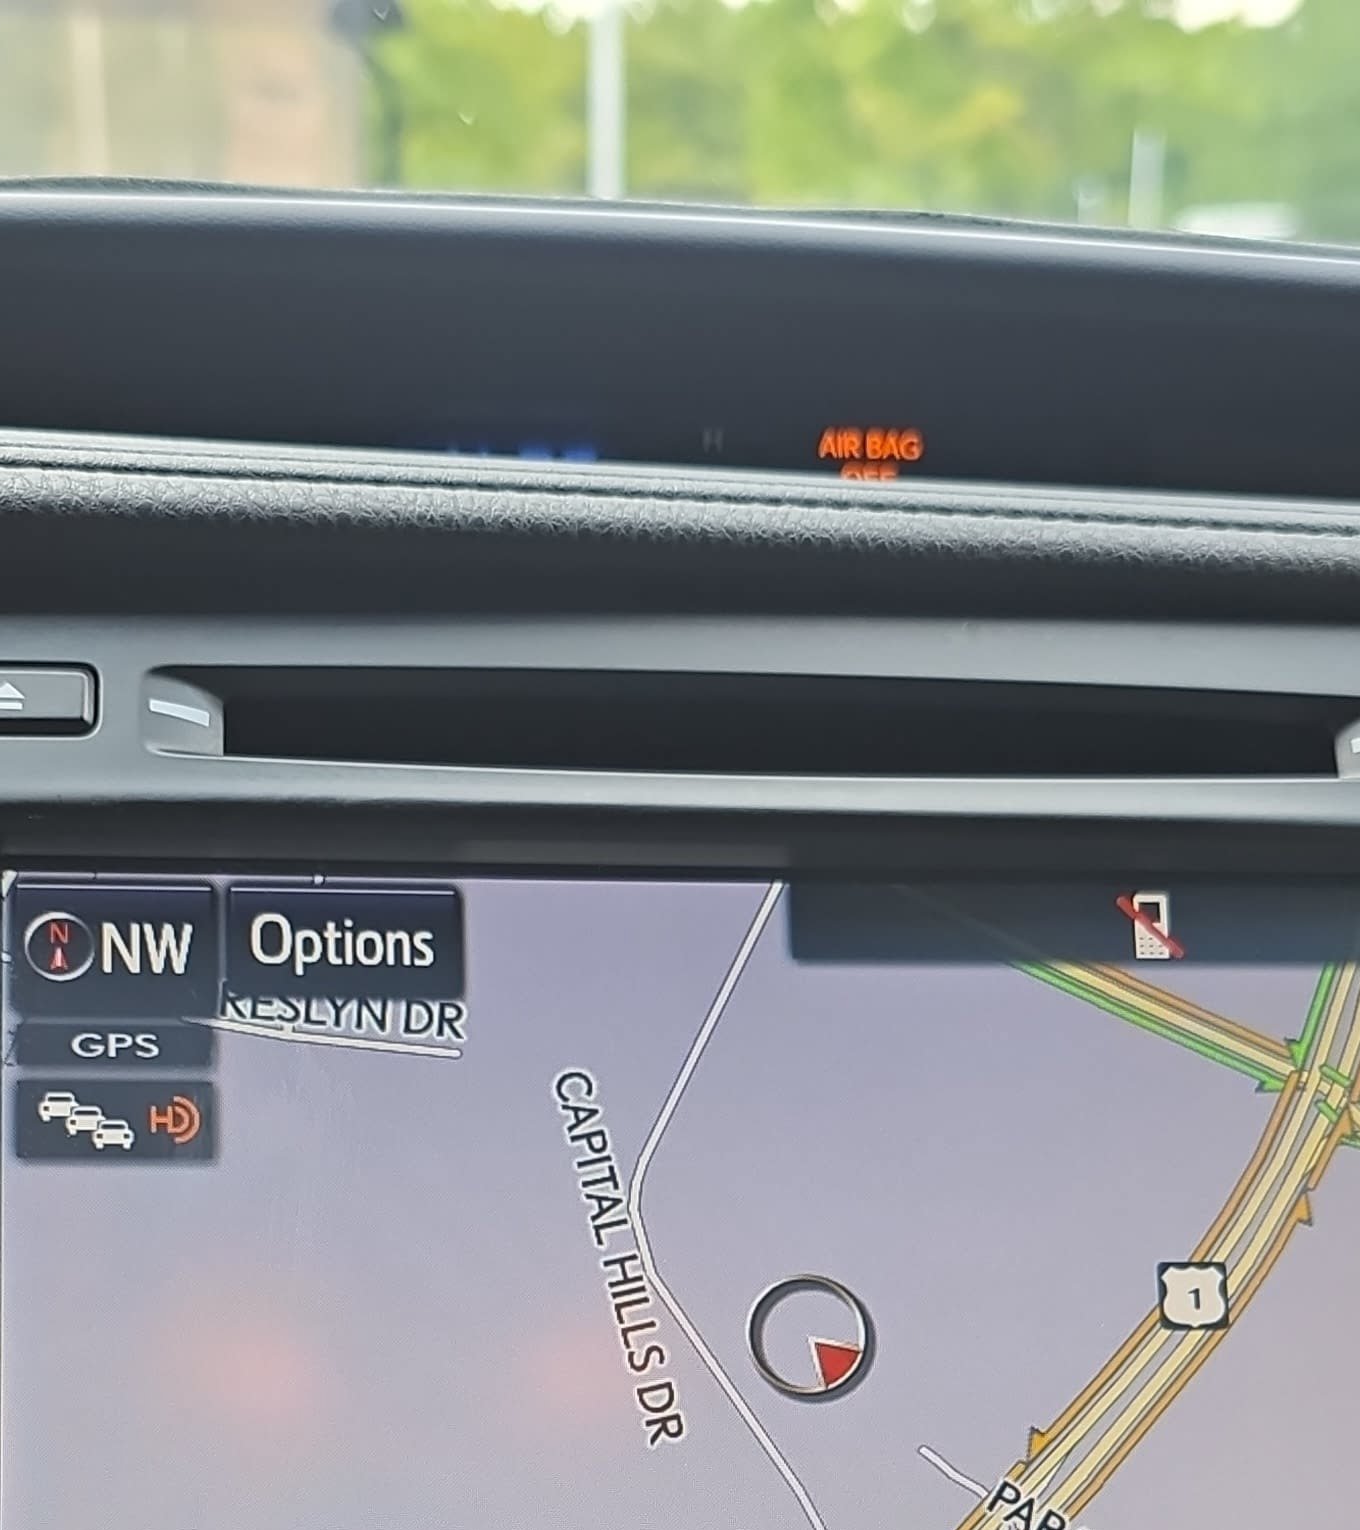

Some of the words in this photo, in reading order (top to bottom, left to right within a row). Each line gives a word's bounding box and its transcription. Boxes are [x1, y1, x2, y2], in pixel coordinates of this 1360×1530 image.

[818, 427, 861, 459] AIR
[865, 427, 923, 460] BAG
[101, 921, 193, 974] NW
[250, 912, 434, 975] Options
[403, 1000, 465, 1039] DR
[71, 1033, 160, 1058] GPS
[556, 1071, 627, 1246] CAPITAL
[604, 1254, 664, 1373] HILLS
[636, 1382, 683, 1446] DR
[1189, 1286, 1202, 1311] 1
